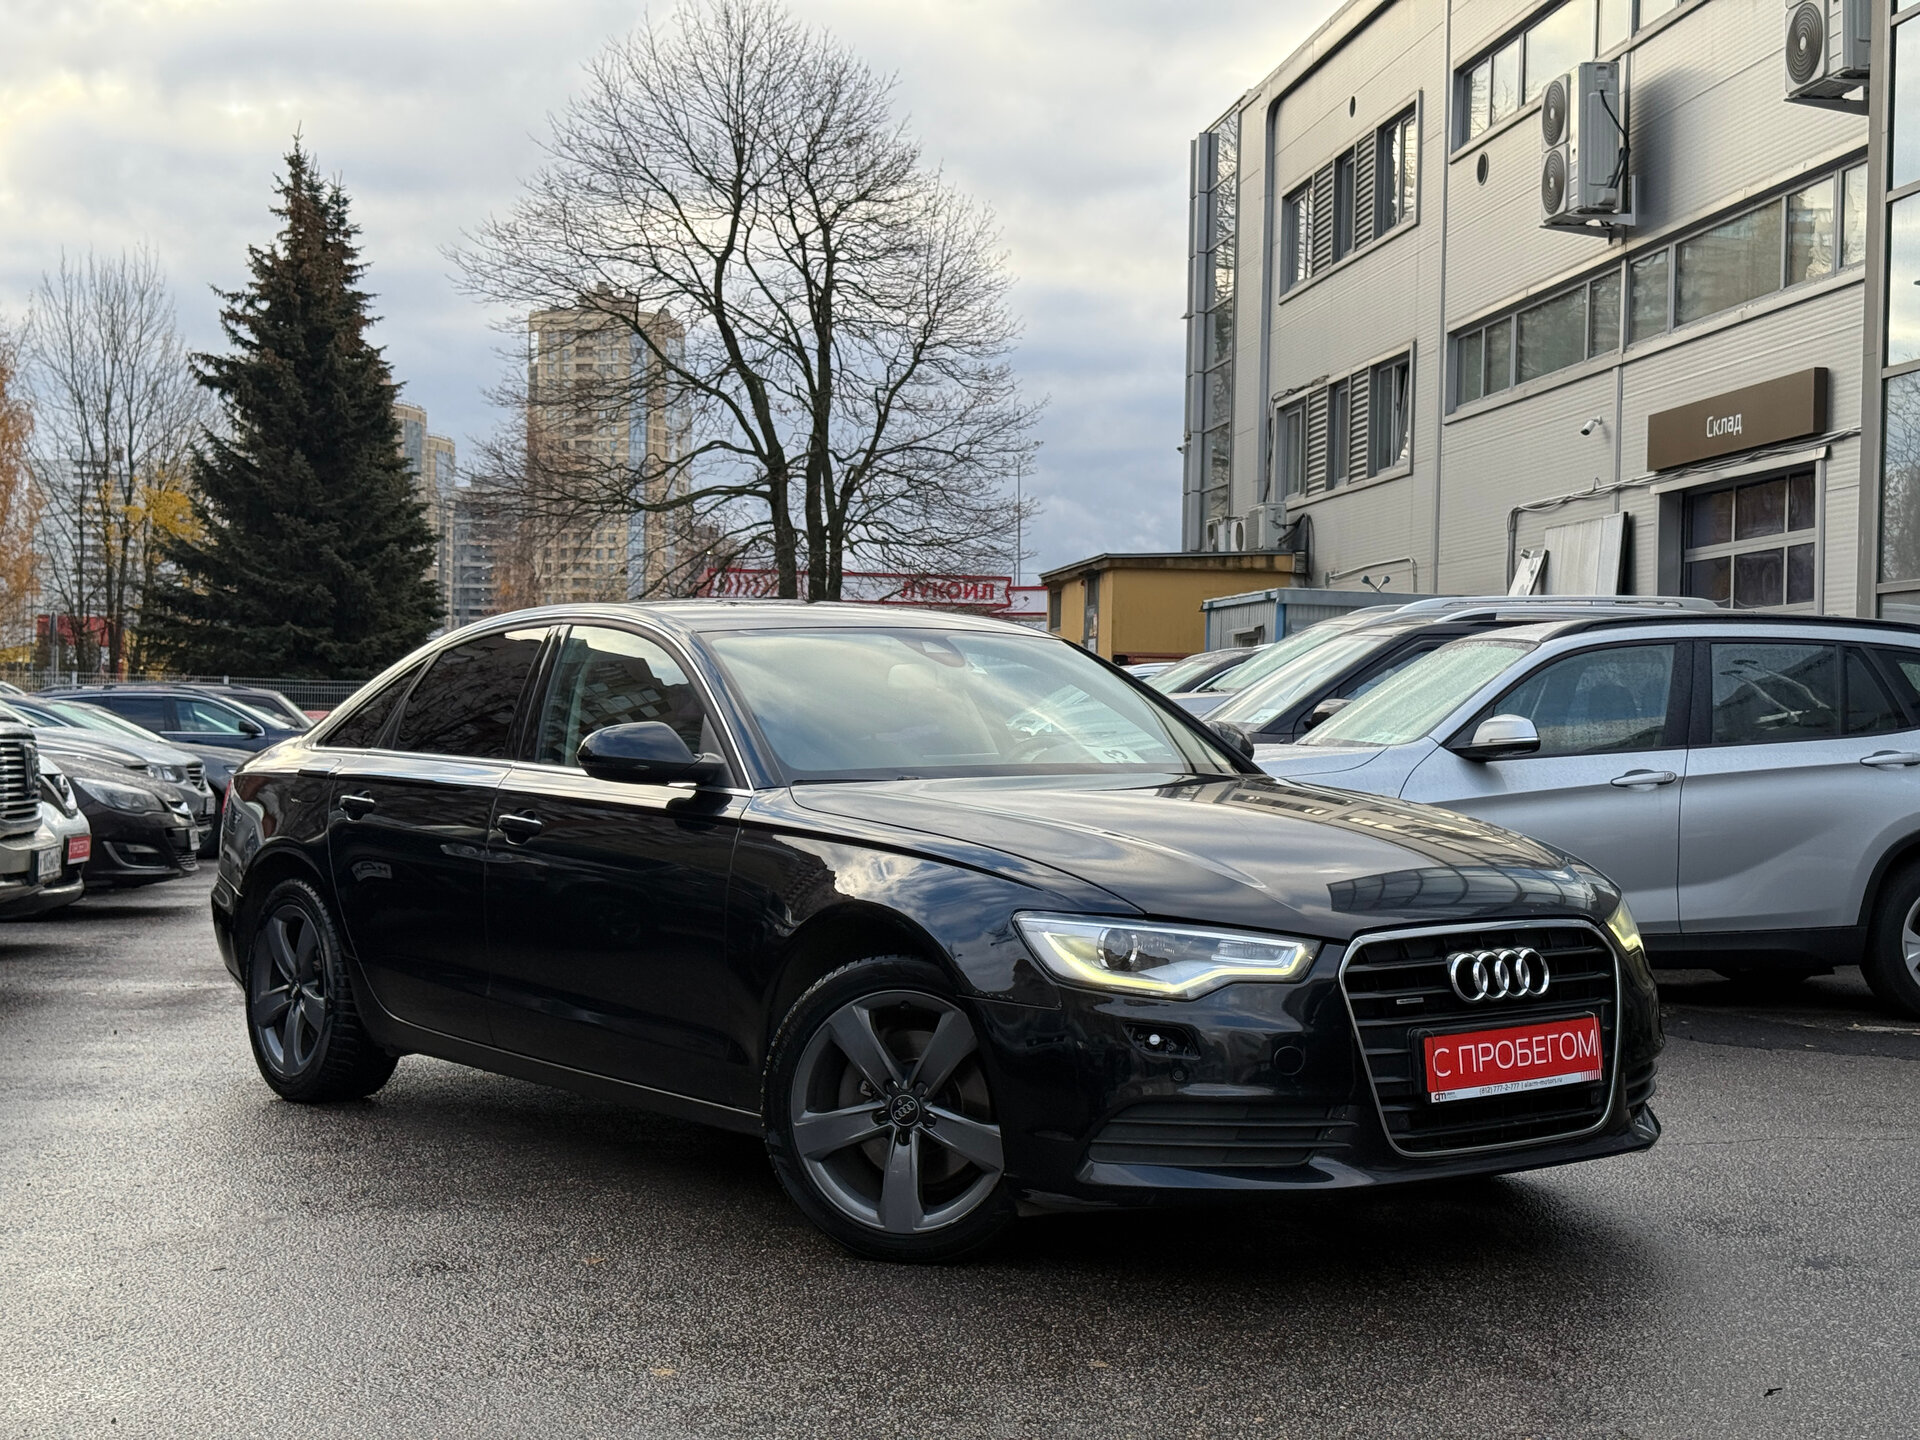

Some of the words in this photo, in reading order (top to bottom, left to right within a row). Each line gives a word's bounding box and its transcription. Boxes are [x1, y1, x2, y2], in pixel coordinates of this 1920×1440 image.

[1706, 413, 1742, 438] Склад
[1432, 1048, 1451, 1077] С
[1458, 1029, 1597, 1075] ПРОБЕГОМ
[1493, 1082, 1520, 1092] 777-2-777
